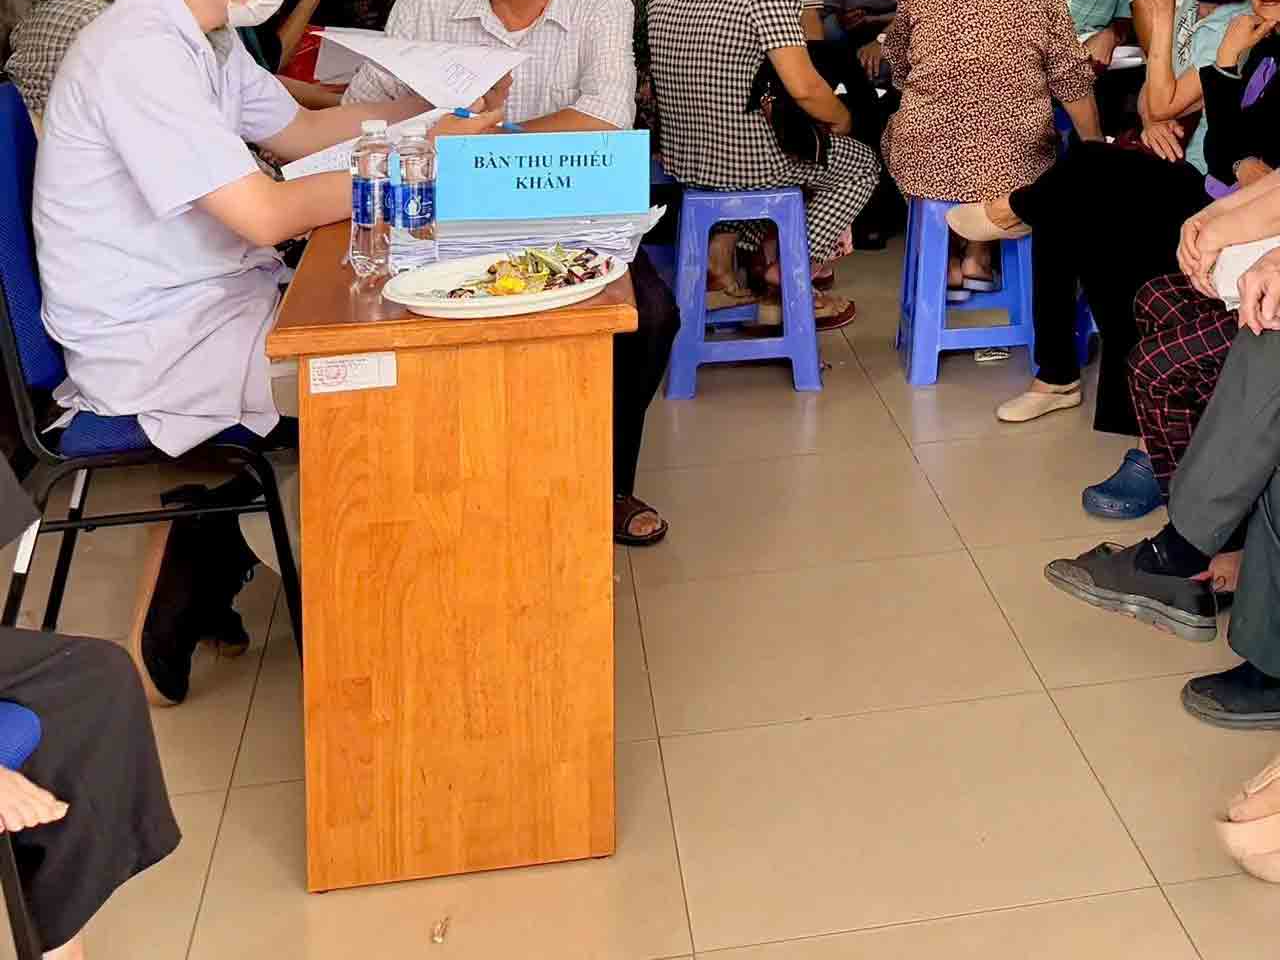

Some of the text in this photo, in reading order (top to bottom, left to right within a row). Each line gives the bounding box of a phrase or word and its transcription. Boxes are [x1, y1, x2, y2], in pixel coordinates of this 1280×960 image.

[474, 150, 615, 169] BÀN THU PHIẾU
[516, 172, 571, 190] KHÁM
